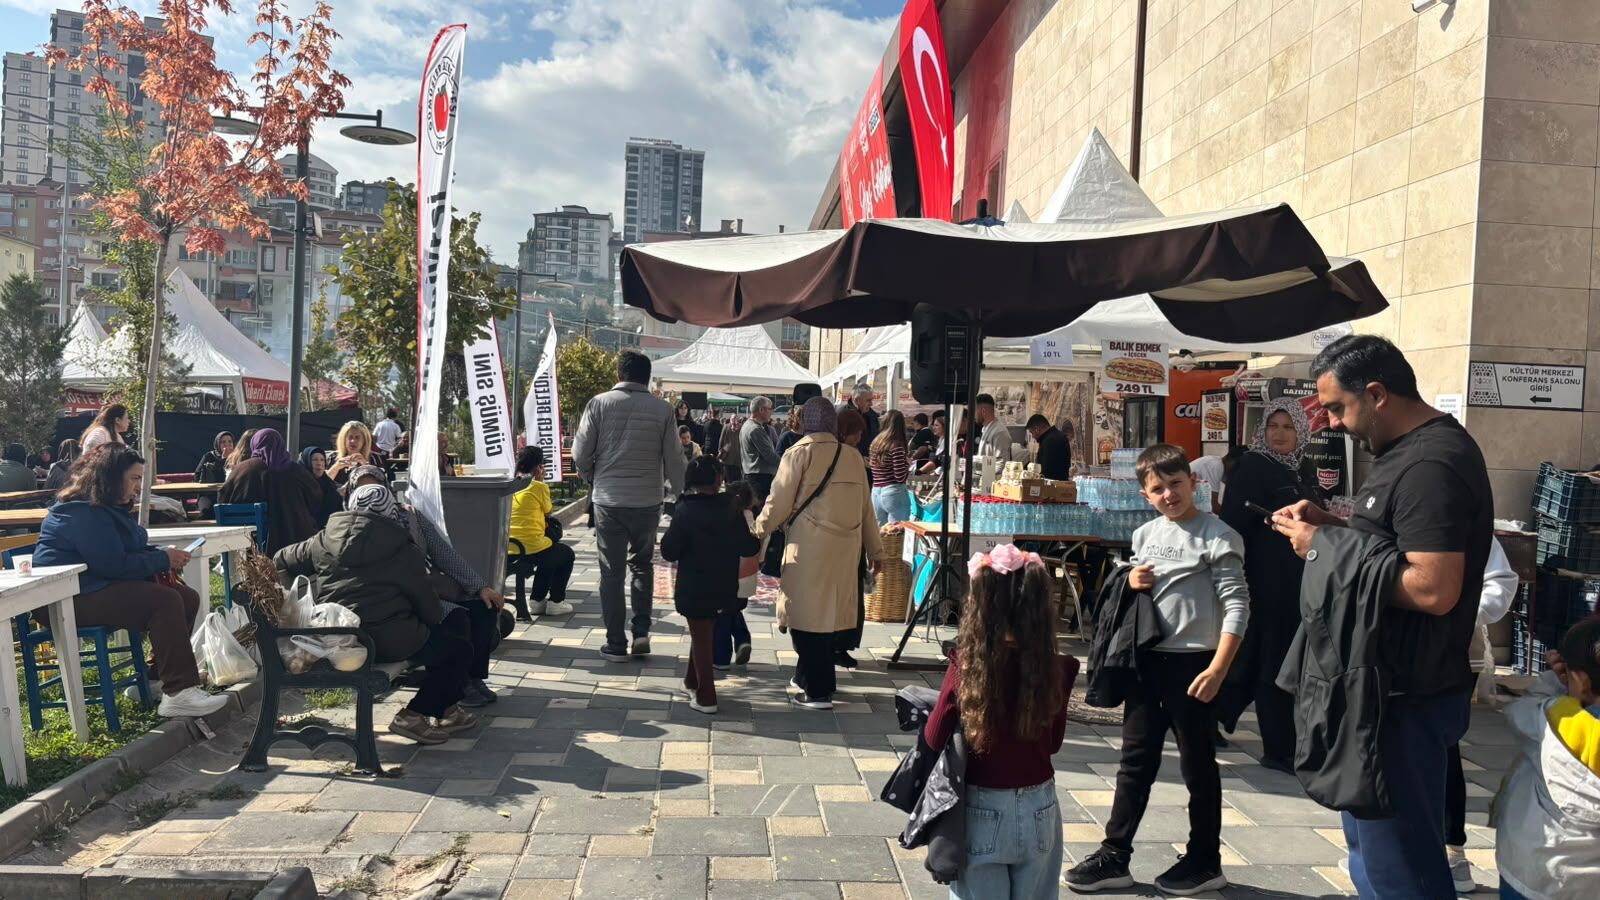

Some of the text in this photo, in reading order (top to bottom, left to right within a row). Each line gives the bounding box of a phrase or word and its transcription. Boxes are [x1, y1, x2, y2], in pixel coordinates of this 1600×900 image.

[1109, 341, 1161, 353] BALIK EKMEK
[1510, 366, 1574, 377] KÜLTÜR MERKEZİ
[1502, 375, 1548, 384] KONFERANS
[1549, 377, 1581, 385] SALONU
[1116, 383, 1155, 394] 249 TL
[1530, 384, 1552, 392] GİRİŞİ
